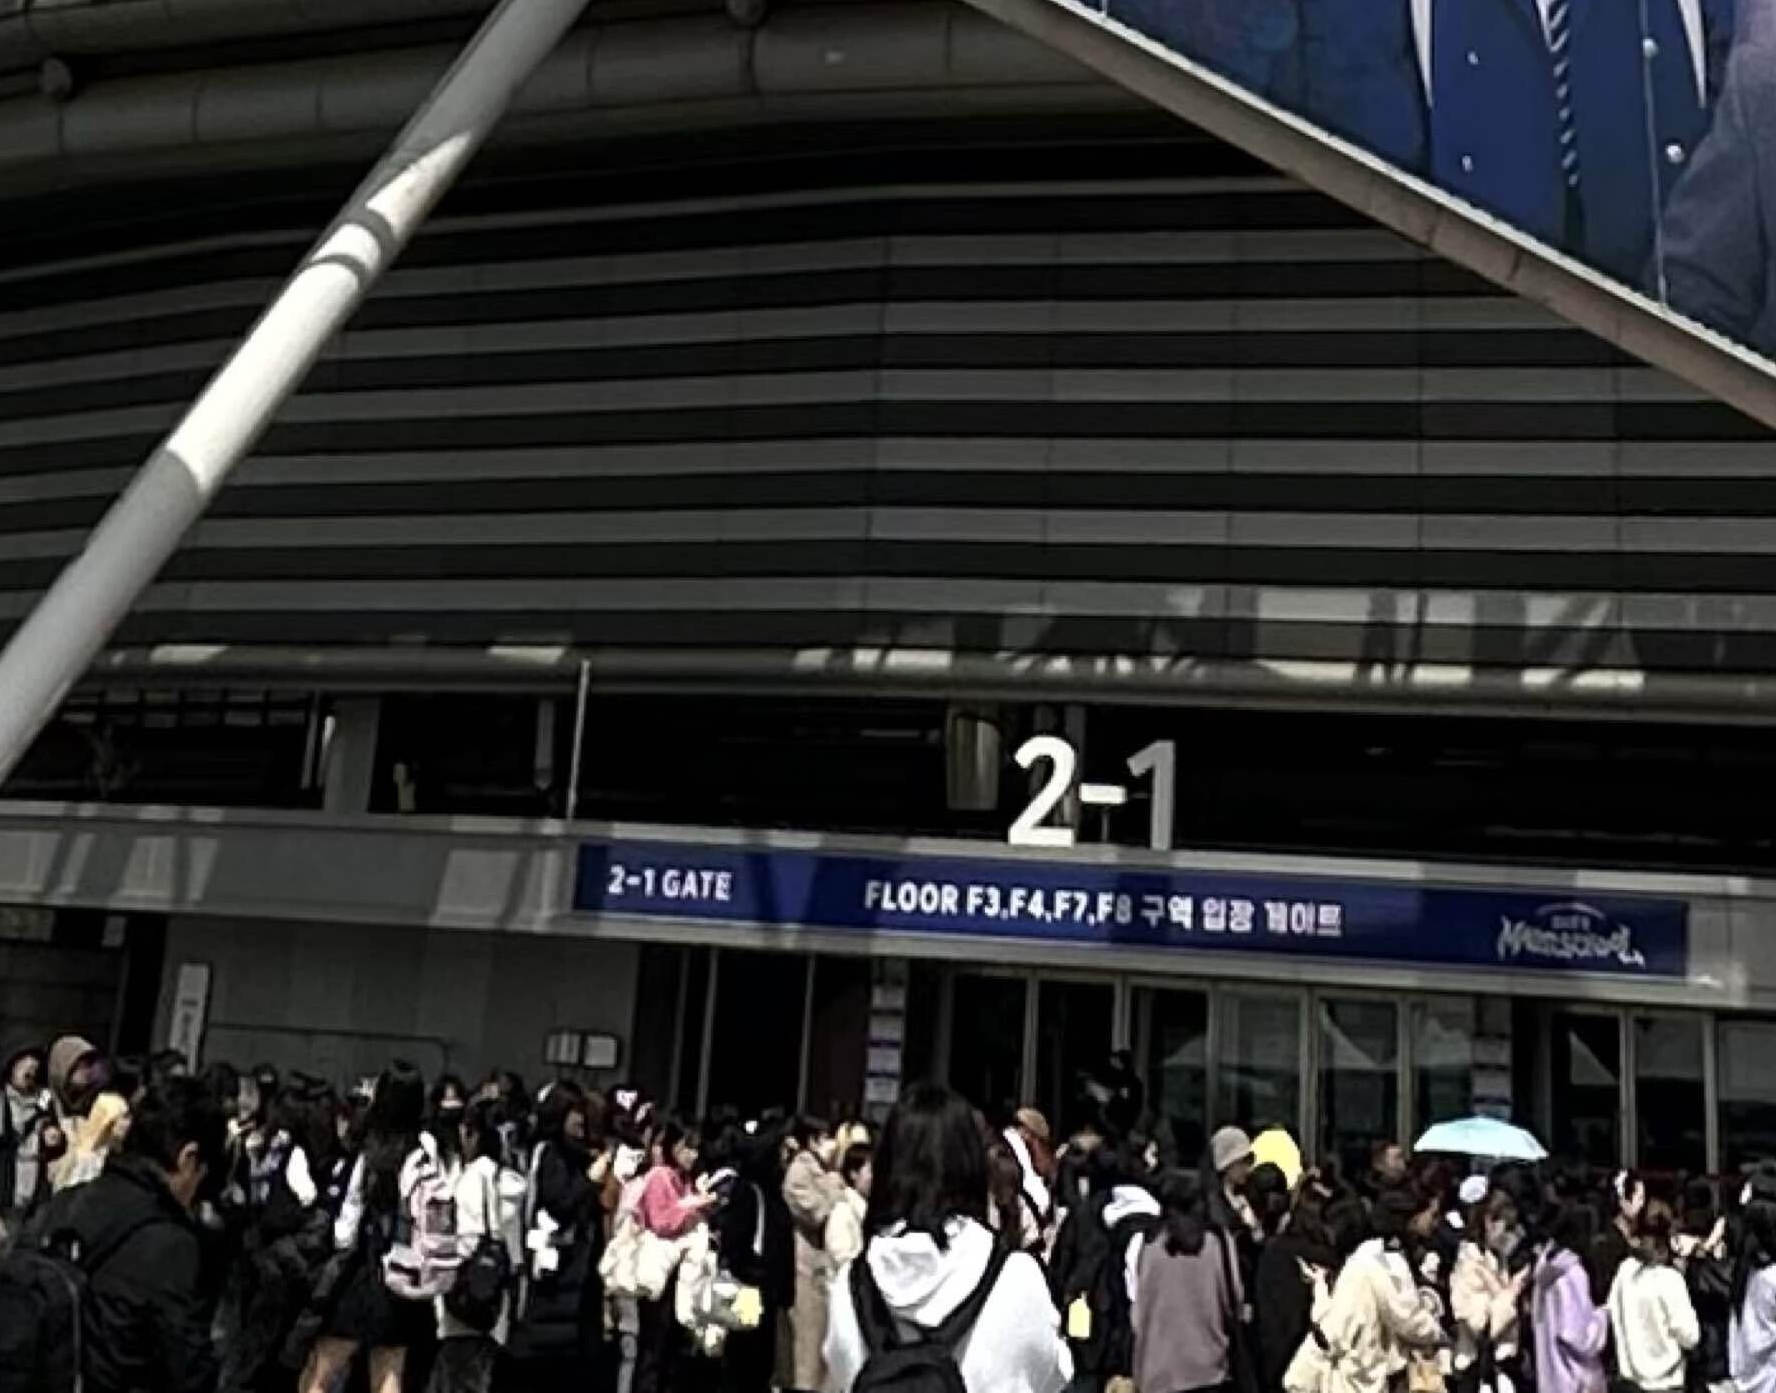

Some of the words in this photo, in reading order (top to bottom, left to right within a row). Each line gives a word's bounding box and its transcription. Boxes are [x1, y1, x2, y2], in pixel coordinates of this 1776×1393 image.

[1008, 734, 1177, 851] 2-1
[608, 864, 656, 896] 2-1
[661, 869, 732, 901] GATE
[865, 881, 960, 915] FLOOR
[1142, 894, 1194, 931] 구역
[1202, 897, 1255, 933] 입장
[1263, 901, 1342, 937] 게이트
